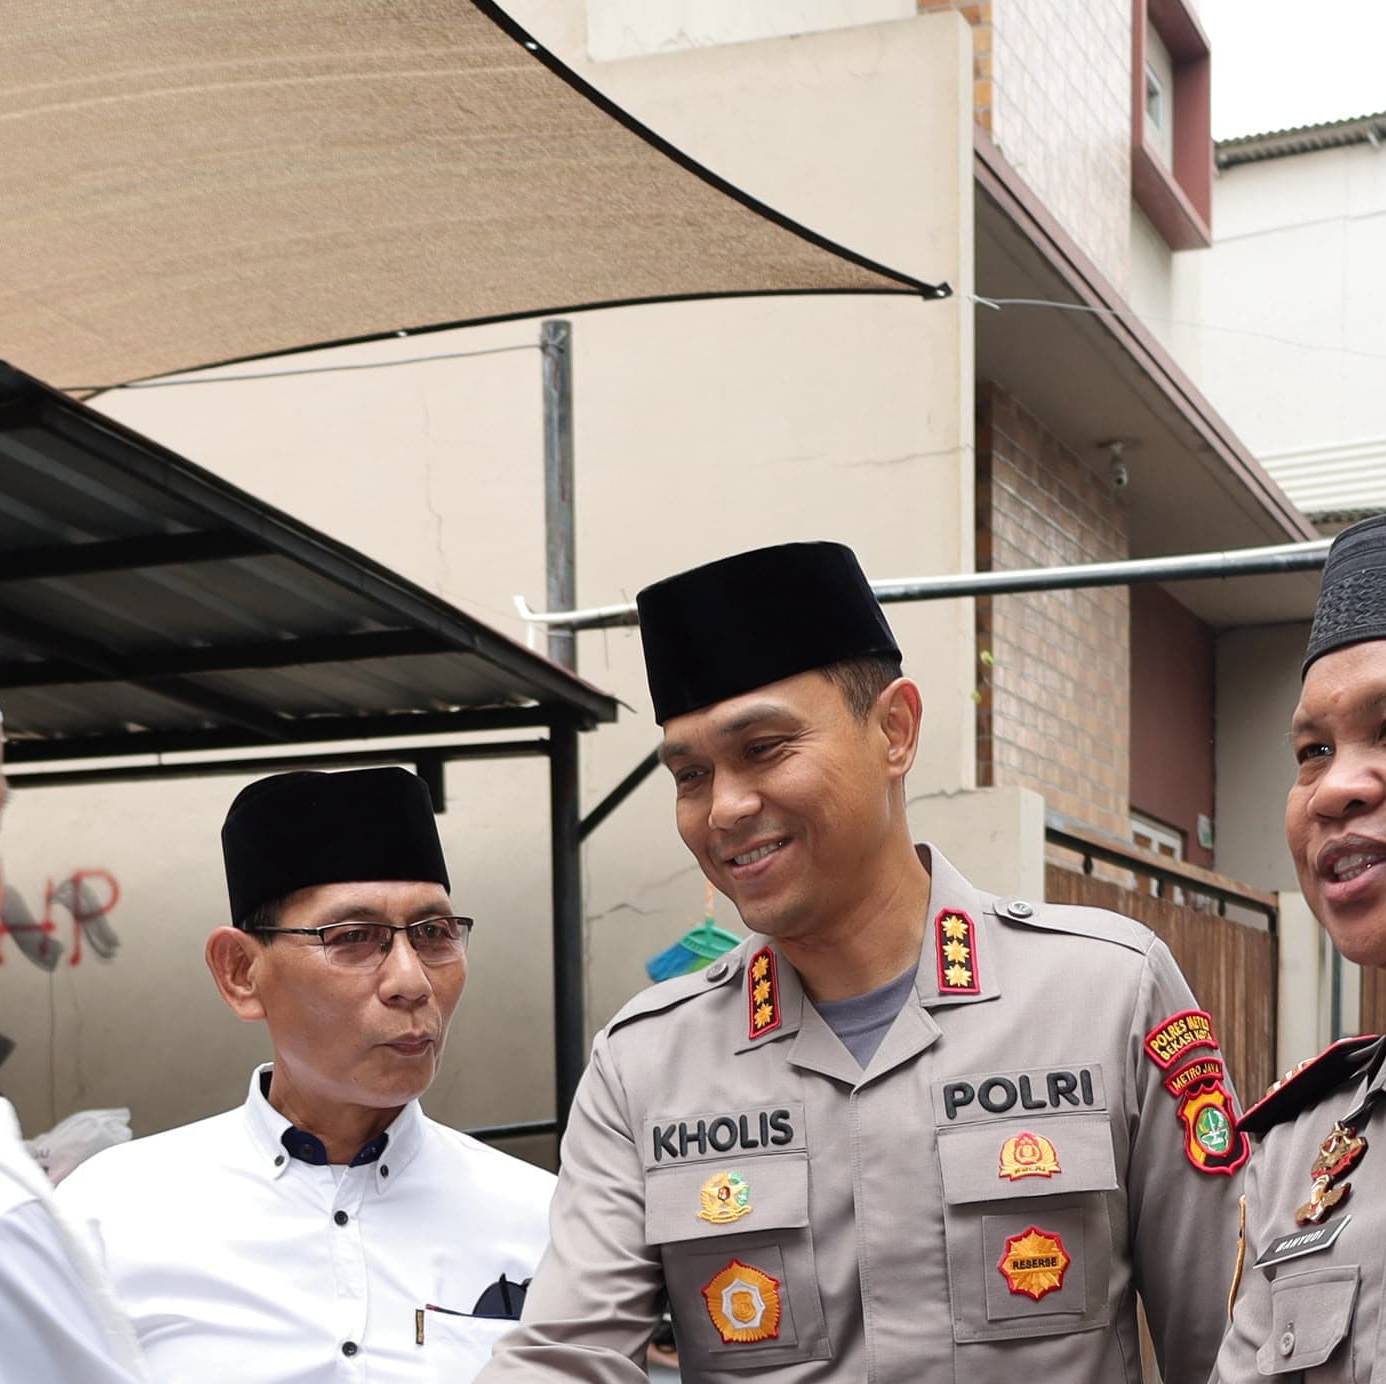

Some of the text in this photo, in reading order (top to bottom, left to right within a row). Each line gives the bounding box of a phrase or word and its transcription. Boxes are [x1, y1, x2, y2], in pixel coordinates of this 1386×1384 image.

[1150, 1019, 1187, 1054] POLRES
[1160, 1031, 1196, 1061] BEKASI
[1172, 1065, 1202, 1091] METRO
[942, 1069, 1096, 1121] POLRI
[652, 1108, 795, 1162] KHOLIS
[1013, 1256, 1057, 1270] RESERSE
